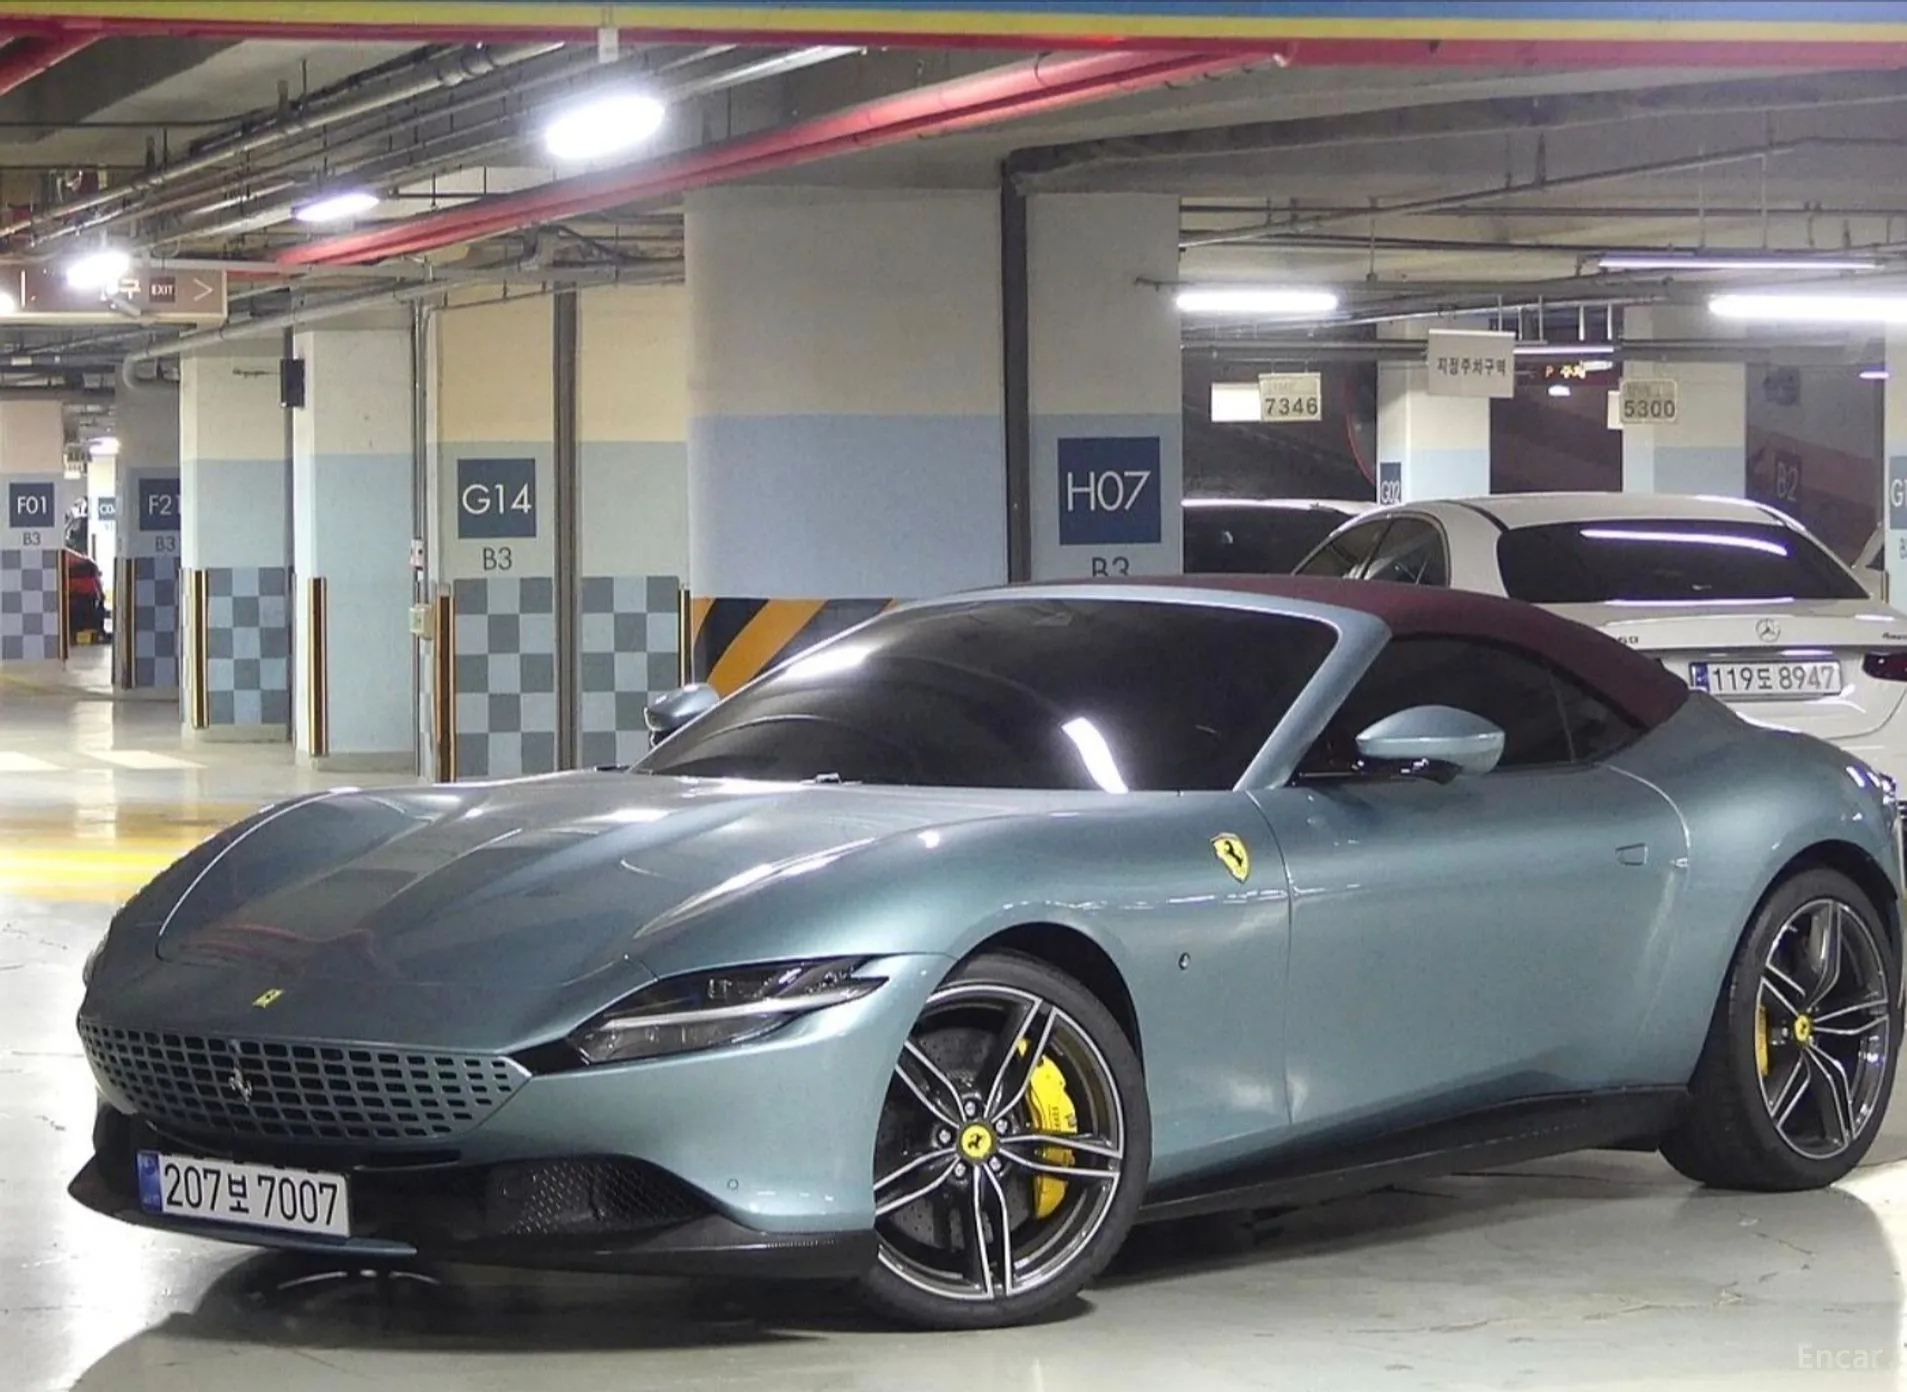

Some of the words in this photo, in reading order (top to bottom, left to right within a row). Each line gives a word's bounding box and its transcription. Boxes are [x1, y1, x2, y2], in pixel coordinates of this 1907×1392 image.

[152, 284, 173, 296] EXIT
[1437, 357, 1505, 377] 지정주차구역
[1265, 396, 1318, 416] 7346
[1623, 399, 1676, 418] 5300
[462, 482, 532, 515] G14
[1067, 470, 1151, 512] H07
[17, 496, 48, 515] F01
[23, 531, 42, 546] B3
[155, 535, 176, 551] B3
[483, 546, 512, 571] B3
[1712, 667, 1773, 691] 119도
[1779, 665, 1836, 690] 8947
[164, 1163, 250, 1214] 207보
[257, 1173, 338, 1226] 7007
